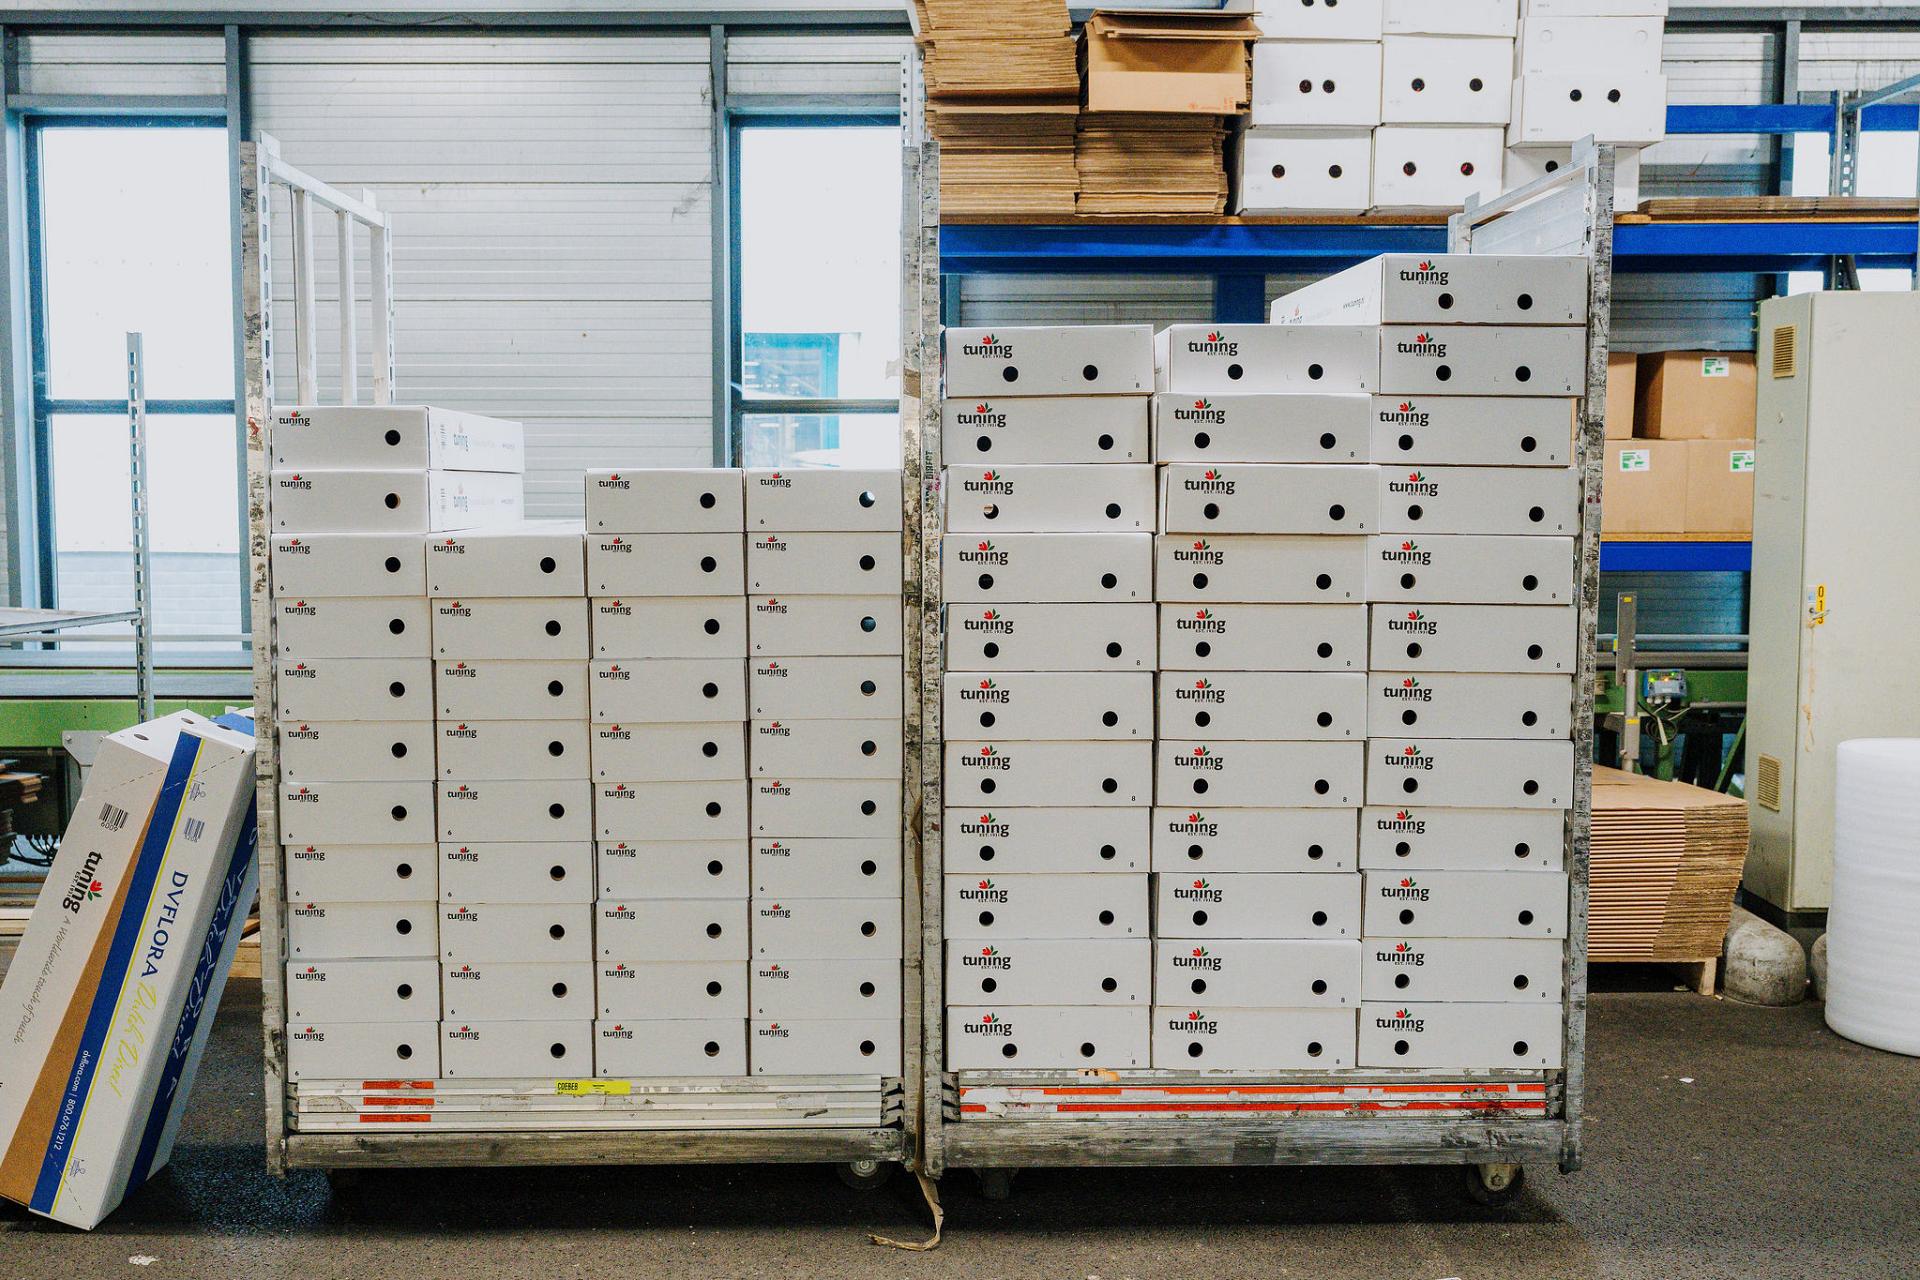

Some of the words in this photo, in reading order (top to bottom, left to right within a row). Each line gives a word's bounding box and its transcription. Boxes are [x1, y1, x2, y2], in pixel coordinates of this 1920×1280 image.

[1400, 269, 1448, 285] tuning
[963, 343, 1012, 358] tuning
[1188, 340, 1237, 356] tuning
[1398, 341, 1446, 357] tuning
[957, 413, 1006, 427] tuning
[1175, 408, 1225, 424] tuning
[1380, 411, 1429, 426] tuning
[279, 418, 310, 427] tuning
[280, 481, 311, 490] tuning
[599, 481, 629, 490] tuning
[760, 479, 791, 489] tuning
[964, 479, 1013, 495] tuning
[1185, 479, 1235, 495] tuning
[1389, 480, 1438, 496] tuning
[279, 546, 310, 555] tuning
[434, 545, 464, 555] tuning
[601, 544, 632, 554] tuning
[756, 542, 786, 552] tuning
[959, 550, 1008, 565] tuning
[1174, 549, 1223, 565] tuning
[1382, 549, 1431, 565] tuning
[285, 607, 315, 616] tuning
[440, 608, 471, 618] tuning
[601, 607, 631, 616] tuning
[757, 605, 787, 614] tuning
[964, 618, 1013, 634] tuning
[1177, 618, 1225, 633] tuning
[1389, 618, 1437, 634] tuning
[285, 670, 315, 679] tuning
[446, 669, 476, 678] tuning
[600, 672, 629, 681] tuning
[758, 669, 787, 678] tuning
[961, 688, 1009, 703] tuning
[1176, 688, 1225, 703] tuning
[1384, 686, 1432, 701] tuning
[288, 731, 319, 740] tuning
[447, 730, 477, 739] tuning
[600, 732, 630, 741] tuning
[760, 728, 790, 737] tuning
[962, 755, 1010, 770] tuning
[1175, 754, 1223, 770] tuning
[1385, 754, 1433, 770] tuning
[448, 791, 478, 801] tuning
[605, 791, 635, 800] tuning
[761, 787, 790, 797] tuning
[288, 794, 318, 803] tuning
[961, 822, 1009, 837] tuning
[1170, 822, 1217, 836] tuning
[1378, 819, 1425, 834] tuning
[295, 853, 325, 862] tuning
[606, 849, 636, 858] tuning
[761, 848, 790, 857] tuning
[448, 854, 478, 863] tuning
[62, 850, 103, 914] tuning
[960, 888, 1007, 903] tuning
[1174, 887, 1222, 902] tuning
[1381, 886, 1429, 901] tuning
[295, 909, 325, 918] tuning
[448, 913, 477, 922] tuning
[606, 911, 635, 920] tuning
[761, 910, 790, 919] tuning
[141, 870, 189, 978] DVFLORA
[963, 954, 1011, 969] tuning
[1173, 955, 1221, 971] tuning
[1377, 951, 1424, 966] tuning
[296, 973, 325, 982] tuning
[451, 972, 480, 981] tuning
[606, 971, 635, 979] tuning
[760, 971, 789, 980] tuning
[964, 1022, 1012, 1036] tuning
[1169, 1019, 1217, 1034] tuning
[1376, 1017, 1424, 1032] tuning
[294, 1033, 324, 1042] tuning
[449, 1032, 479, 1041] tuning
[603, 1031, 632, 1040] tuning
[759, 1030, 789, 1038] tuning
[71, 1050, 91, 1092] dvflora.com
[53, 1099, 76, 1151] 800.676.1212
